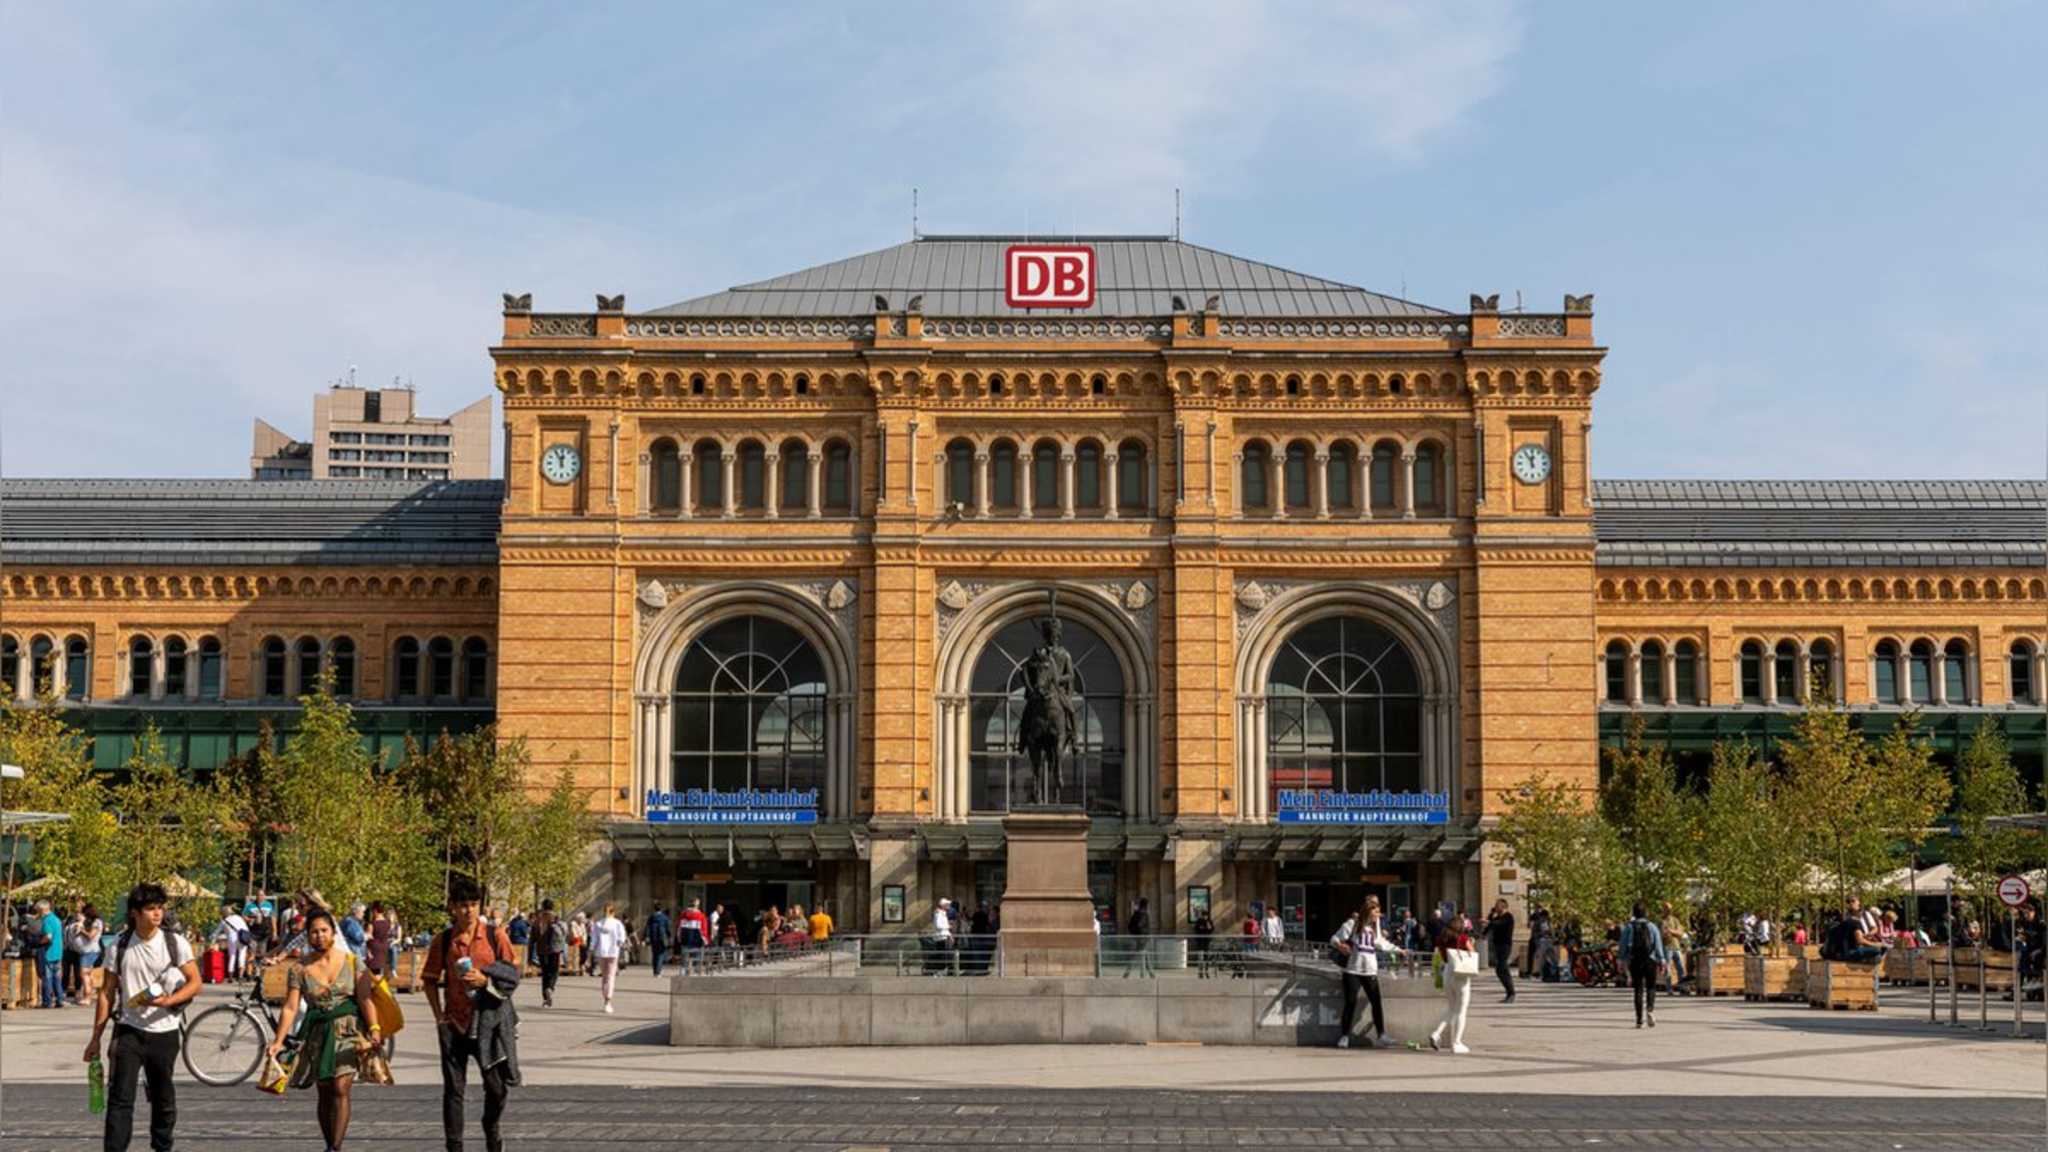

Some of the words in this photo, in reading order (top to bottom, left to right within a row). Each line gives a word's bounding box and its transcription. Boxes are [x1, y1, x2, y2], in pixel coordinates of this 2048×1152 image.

[1018, 256, 1085, 296] DB
[647, 789, 685, 807] Mein
[687, 788, 818, 808] Einkaufsbahnhof
[1278, 789, 1316, 807] Mein
[1318, 788, 1449, 808] Einkaufsbahnhof
[667, 812, 718, 822] HANNOVER
[721, 812, 797, 822] HAUPTBAHNHOF
[1298, 812, 1350, 822] HANNOVER
[1353, 812, 1429, 822] HAUPTBAHNHOF
